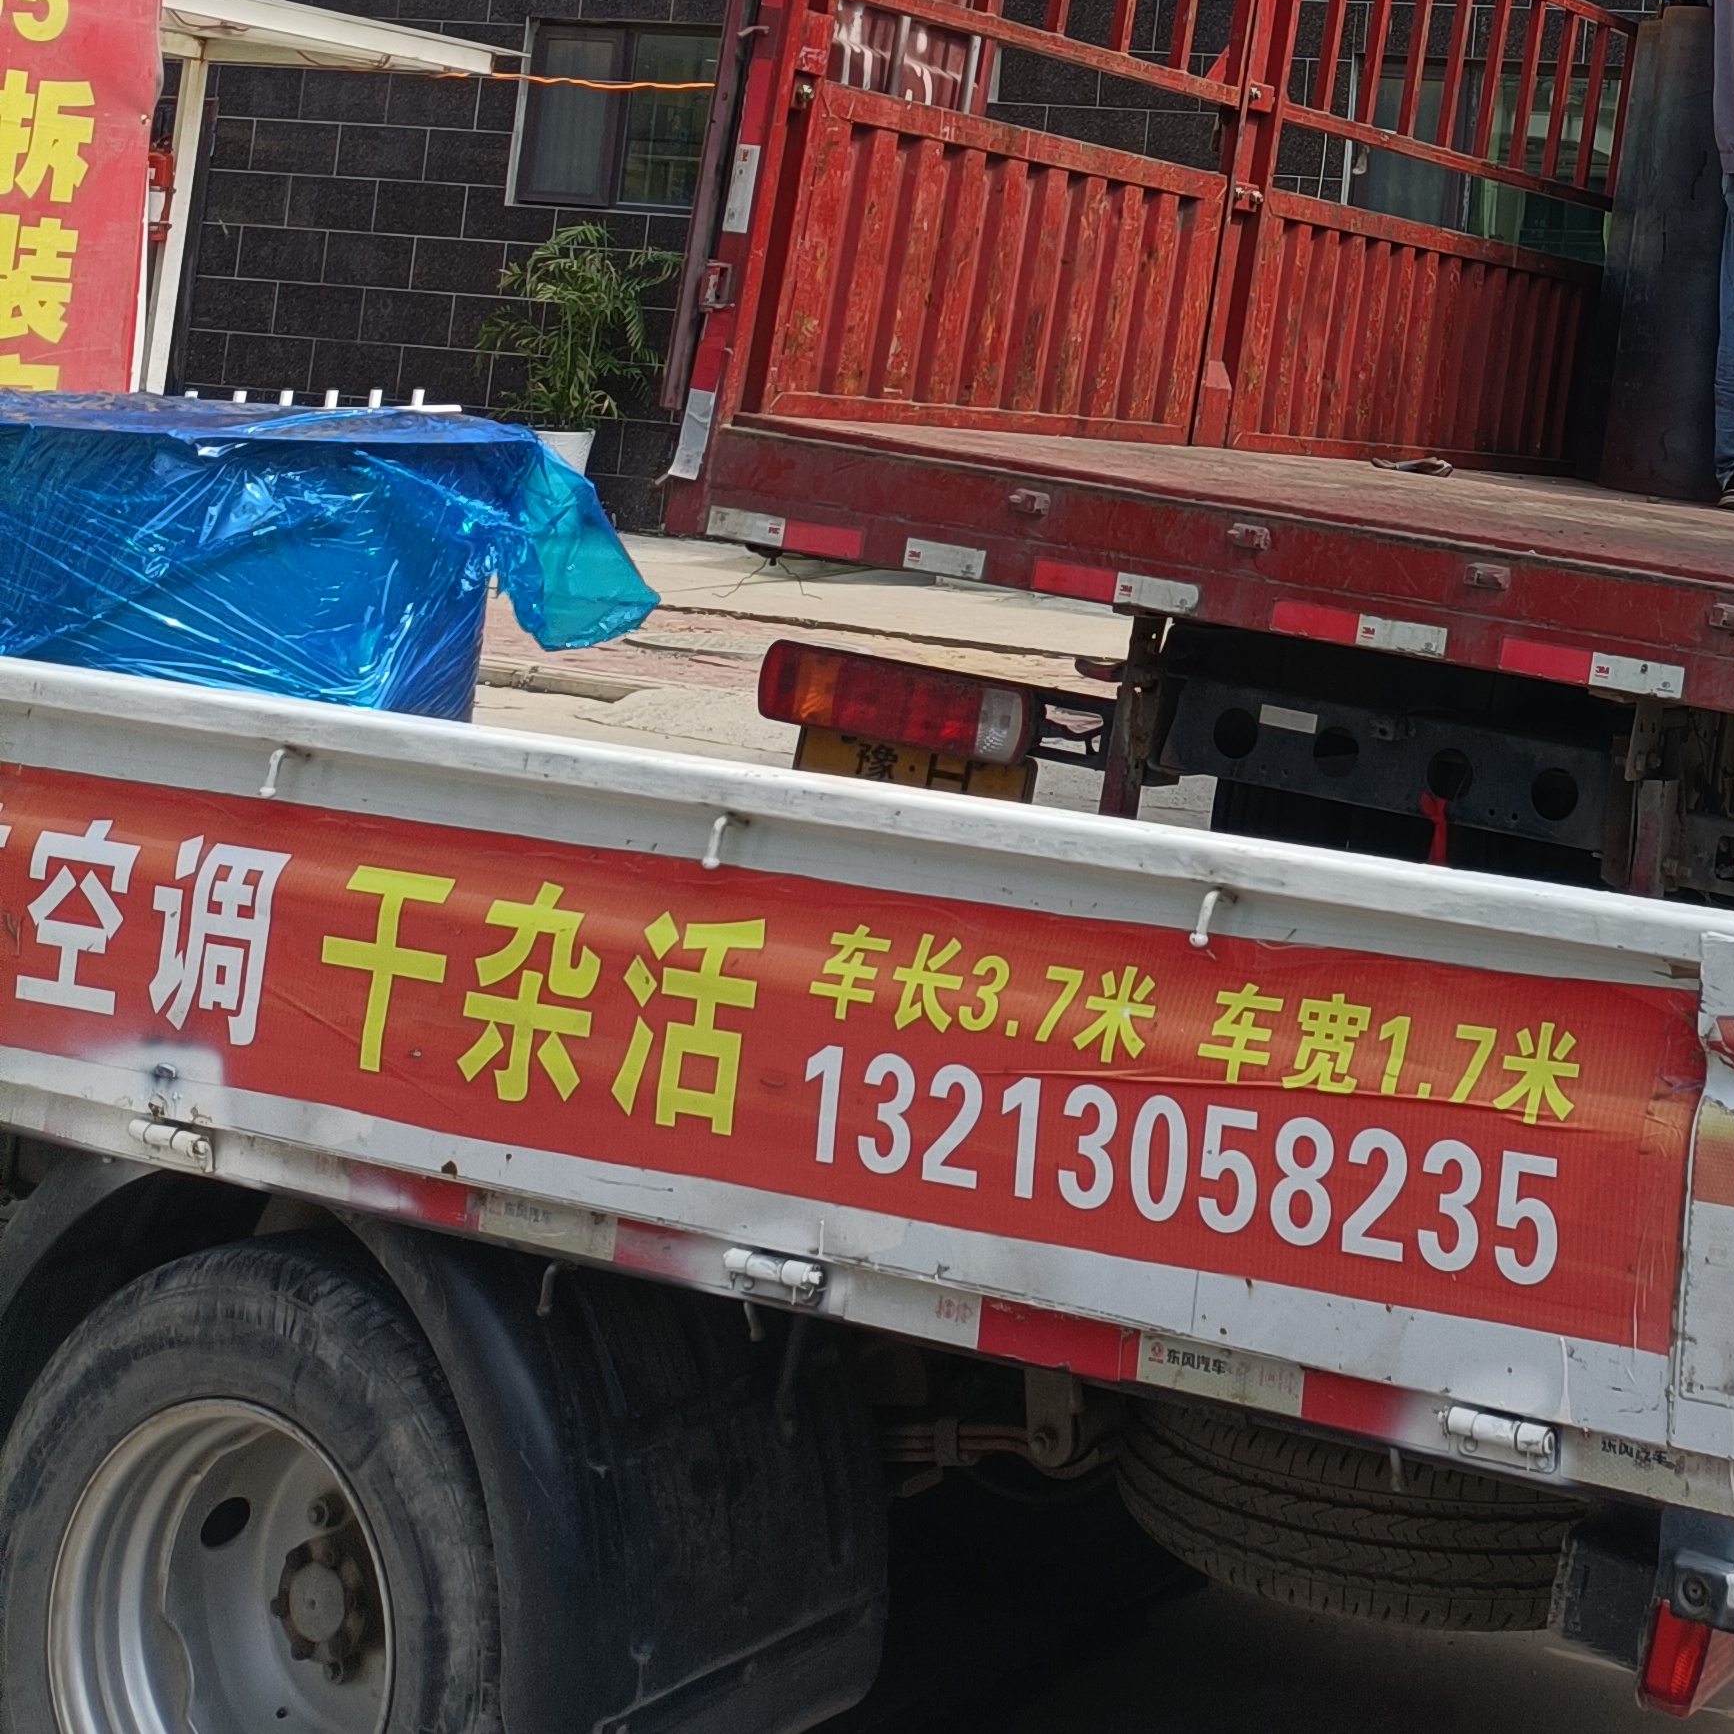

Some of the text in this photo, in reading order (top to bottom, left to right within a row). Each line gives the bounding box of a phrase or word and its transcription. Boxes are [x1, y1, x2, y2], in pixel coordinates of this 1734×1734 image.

[0, 803, 1580, 1136] 空调 干杂活 车长3.7米 车宽1.7米
[804, 1044, 1560, 1286] 13213058235
[1166, 1347, 1227, 1376] 东风汽车
